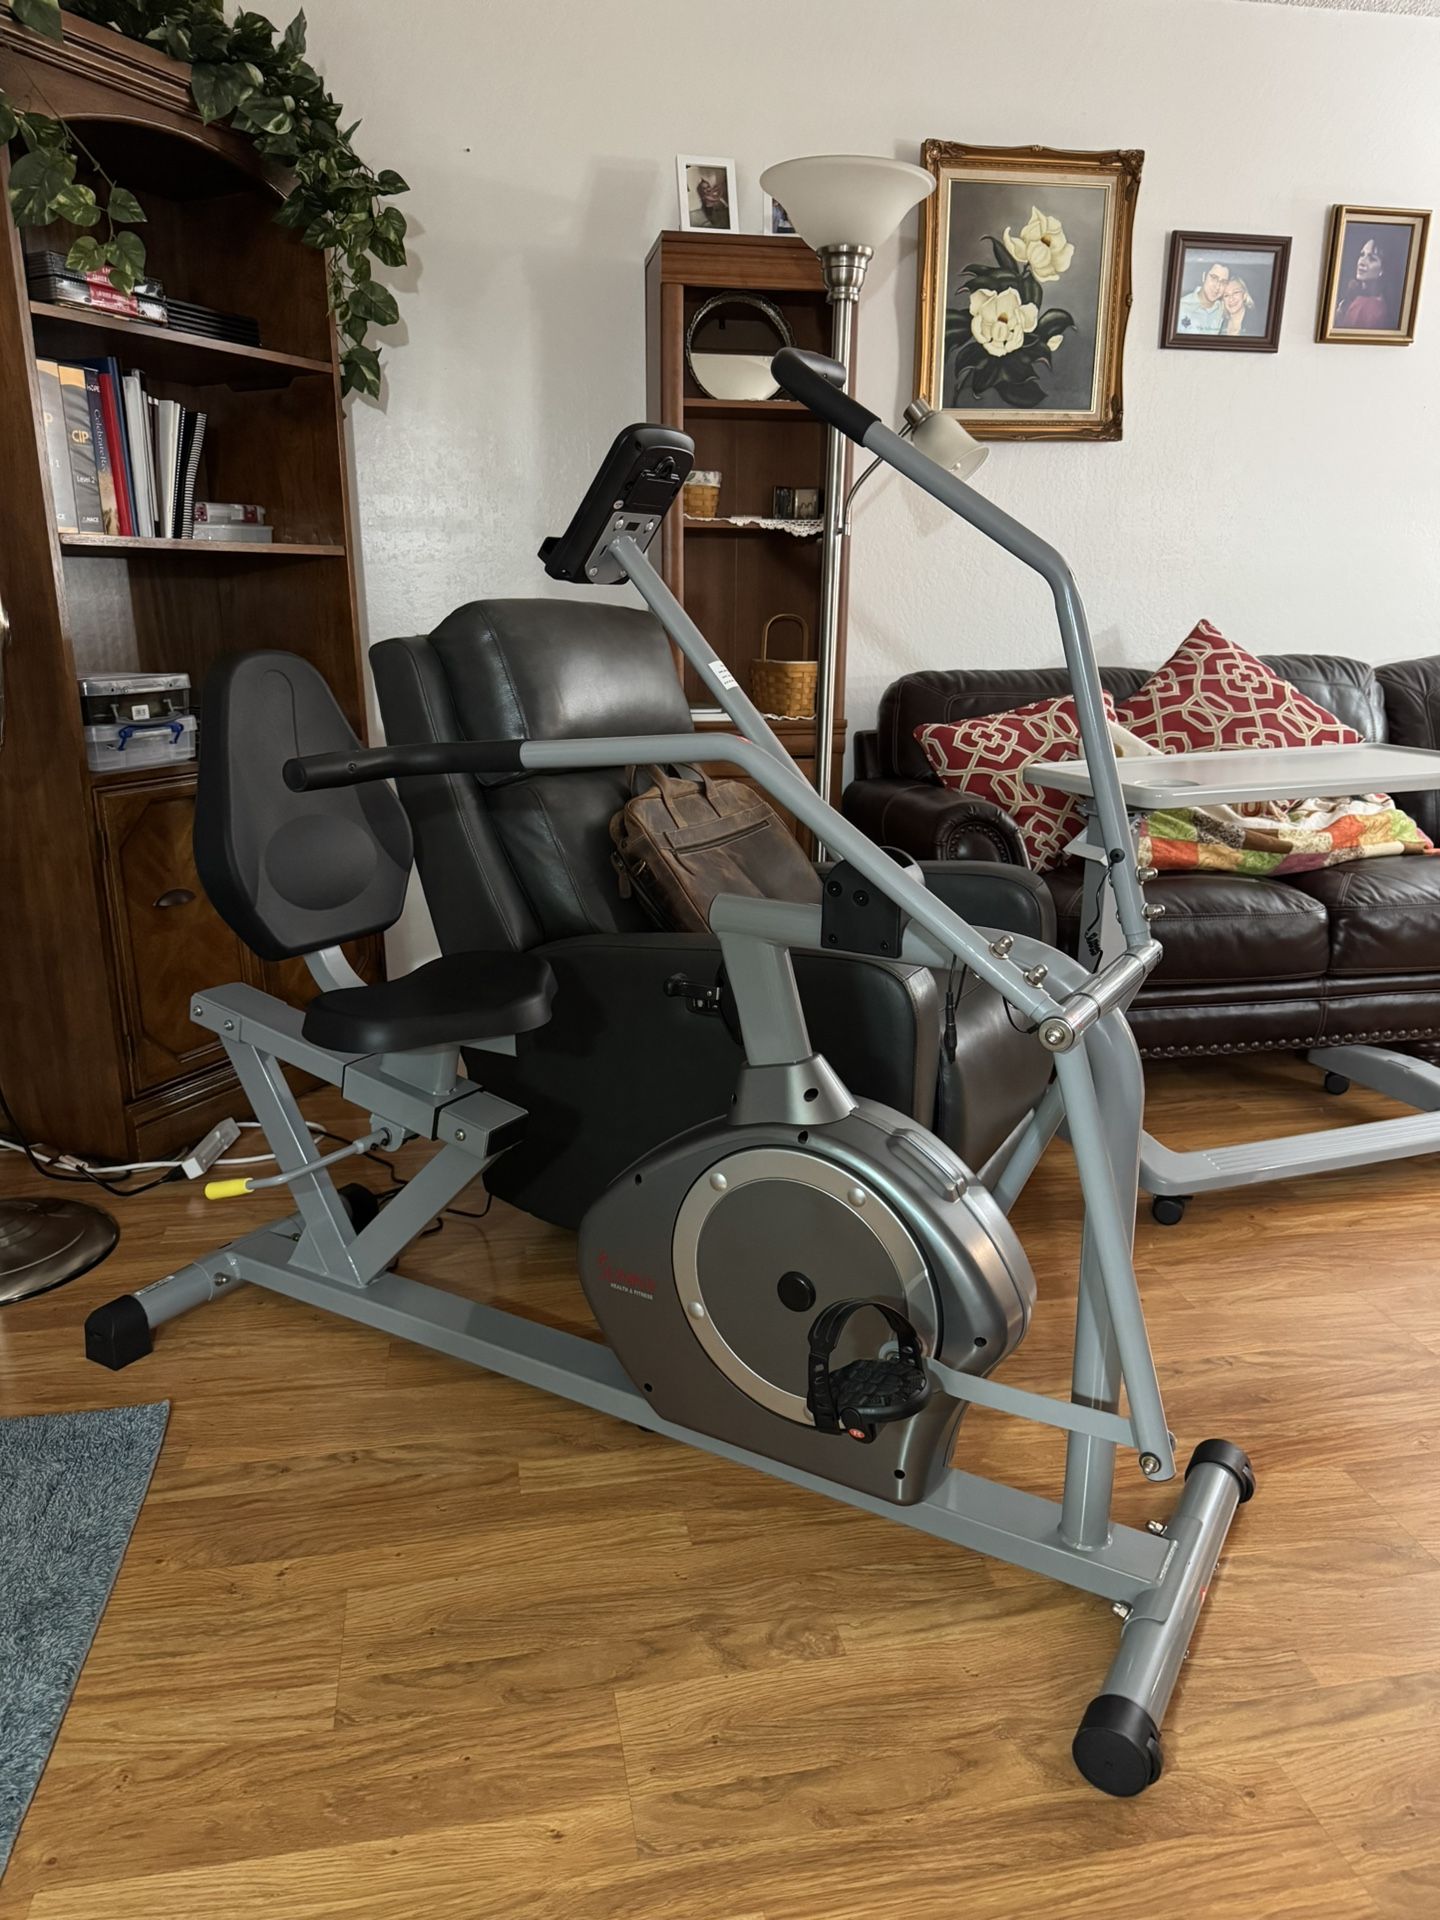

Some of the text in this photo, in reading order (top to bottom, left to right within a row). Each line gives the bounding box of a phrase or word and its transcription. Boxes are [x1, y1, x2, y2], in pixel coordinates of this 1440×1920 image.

[72, 430, 89, 444] CIP
[610, 1282, 629, 1292] HEALTH
[633, 1289, 654, 1300] FITNESS
